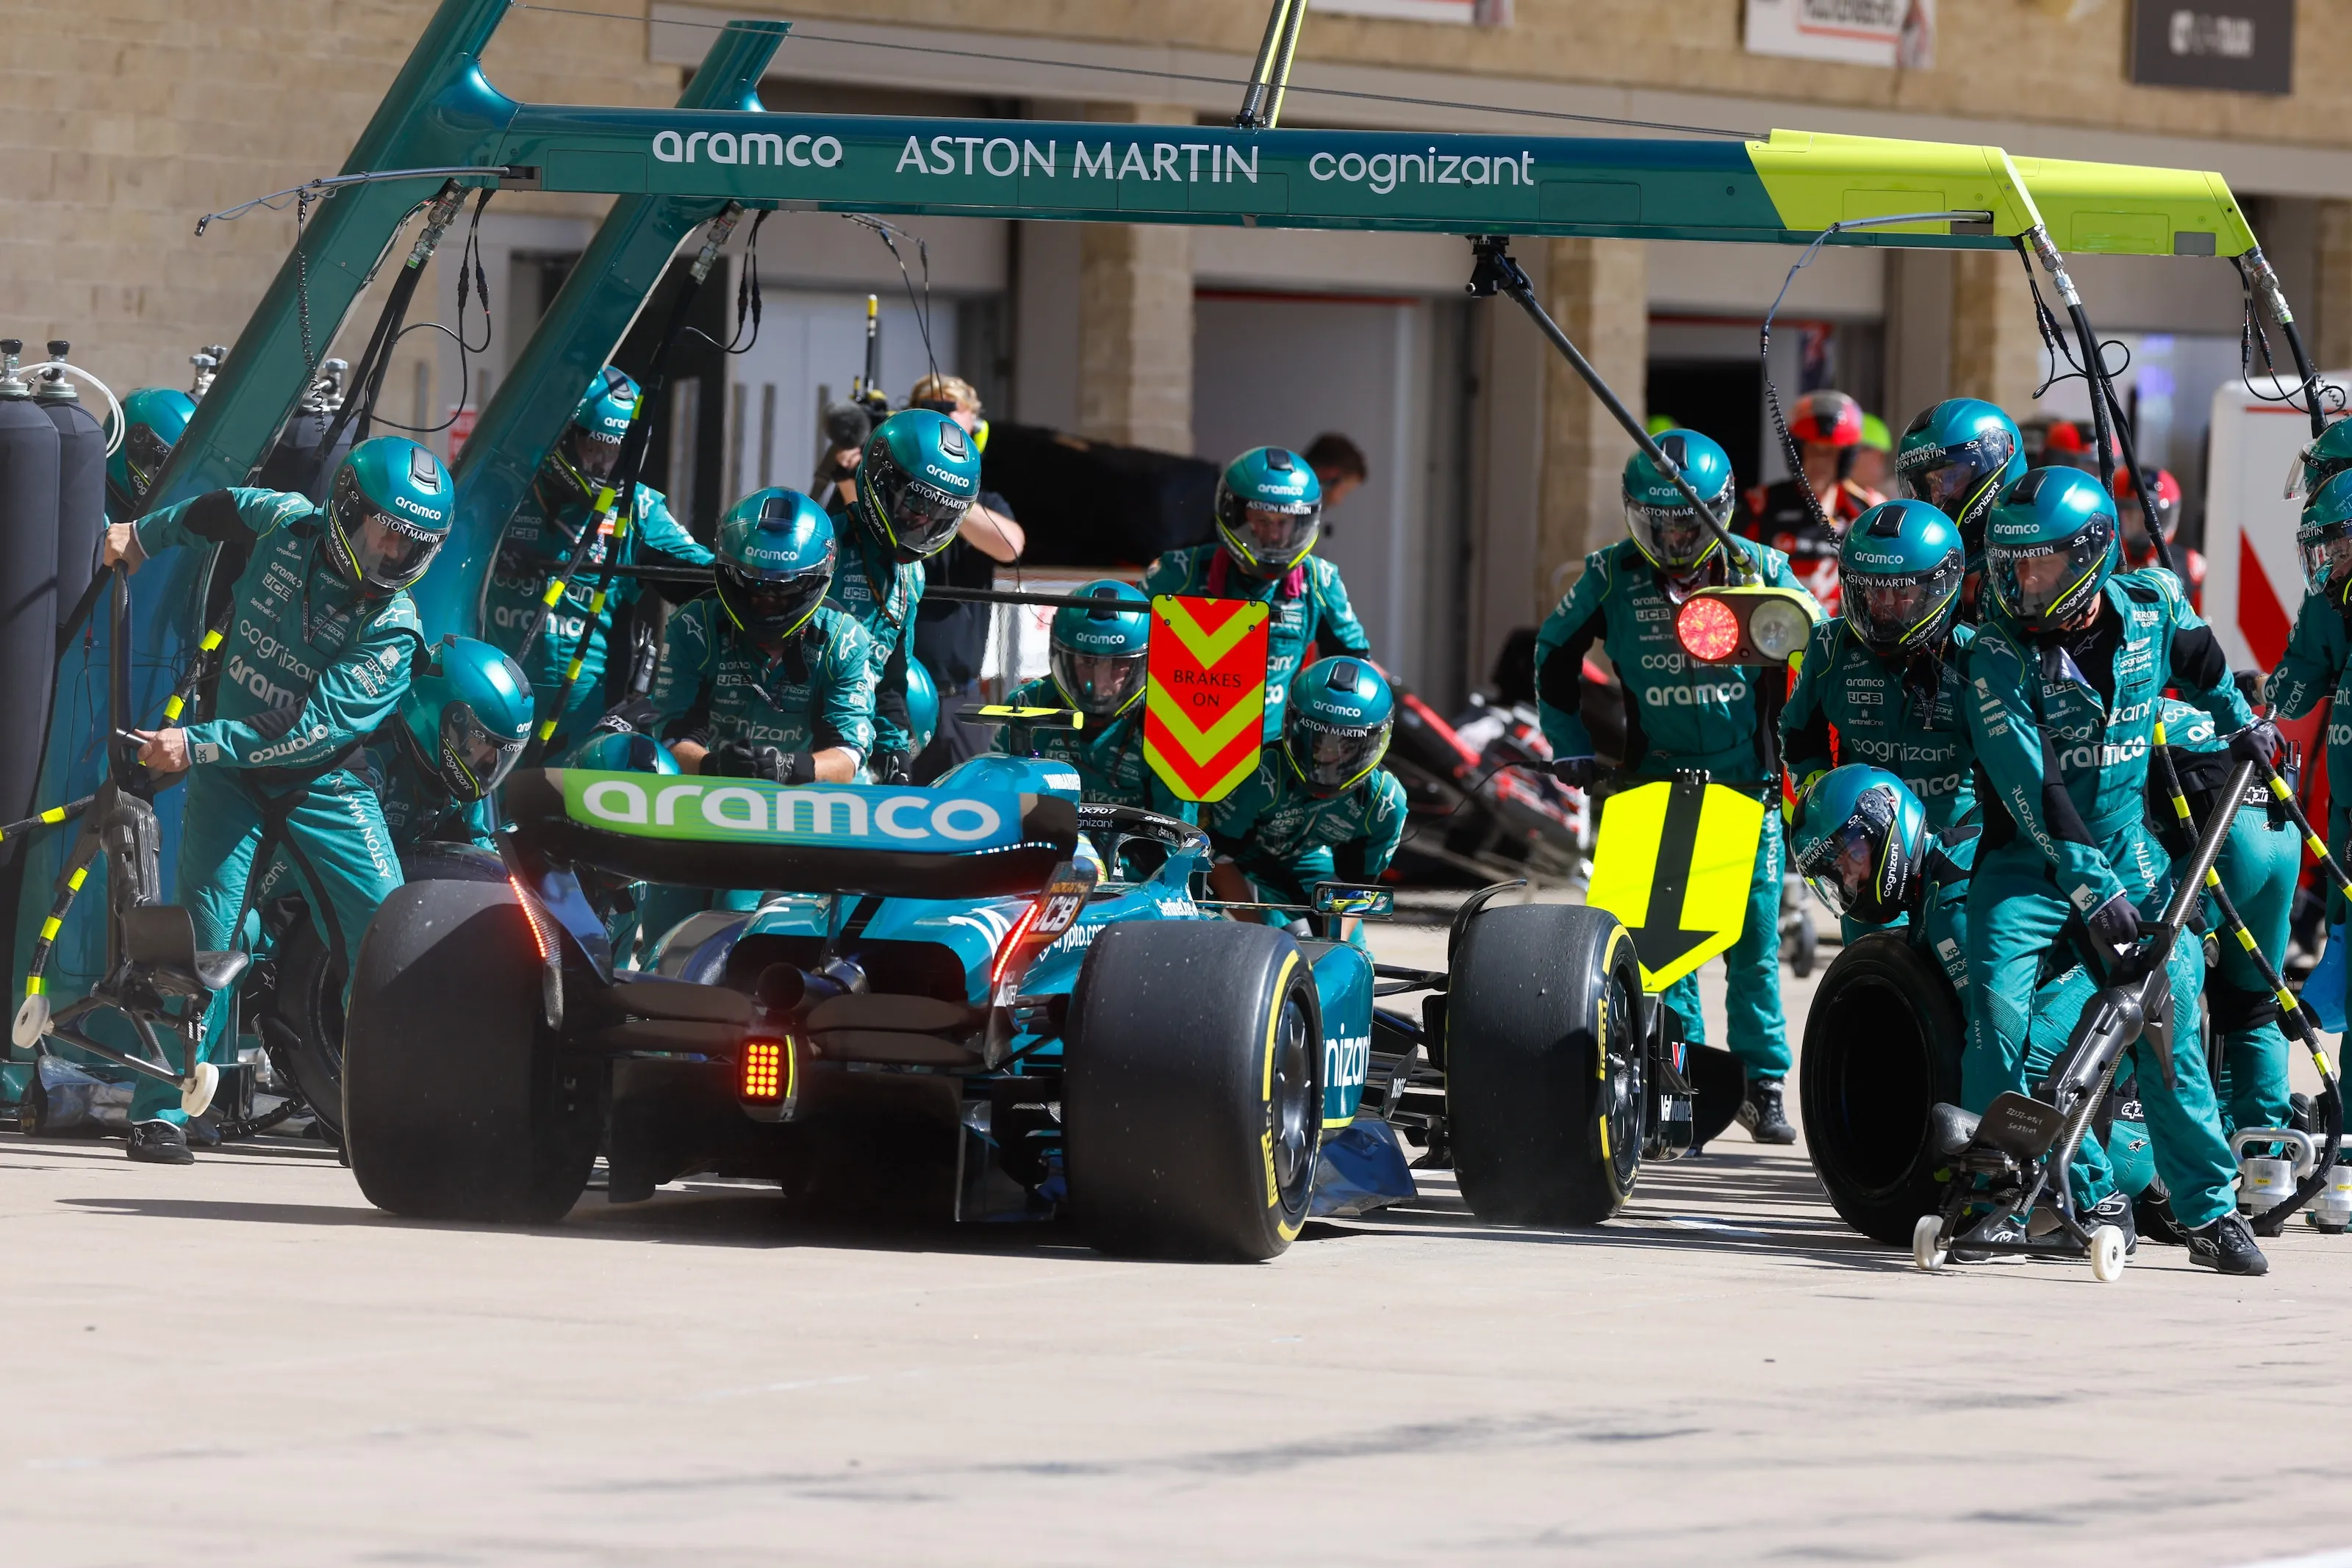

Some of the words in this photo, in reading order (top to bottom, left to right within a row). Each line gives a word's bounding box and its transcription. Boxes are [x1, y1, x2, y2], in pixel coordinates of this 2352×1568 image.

[653, 130, 843, 168] aramco
[895, 135, 1055, 178] ASTON
[1073, 140, 1258, 184] MARTIN
[1309, 147, 1535, 195] cognizant
[588, 431, 622, 445] ASTON
[1899, 442, 1937, 461] aramco
[1911, 447, 1947, 464] MARTIN
[926, 464, 969, 488] aramco
[907, 480, 939, 502] ASTON
[938, 496, 969, 510] MARTIN
[1258, 483, 1304, 496] aramco
[395, 496, 442, 521] aramco
[863, 486, 886, 534] cognizant
[1246, 500, 1278, 512] ASTON
[1279, 506, 1312, 514] MARTIN
[1640, 506, 1670, 517] ASTON
[1964, 481, 2001, 524] cognizant
[373, 512, 406, 535] ASTON
[408, 528, 440, 544] MARTIN
[1993, 524, 2040, 535] aramco
[2298, 526, 2324, 540] MARTIN
[329, 516, 351, 567] cognizant
[745, 546, 797, 561] aramco
[1854, 551, 1904, 564] aramco
[1988, 547, 2011, 558] ASTON
[2012, 545, 2054, 558] MARTIN
[270, 561, 303, 589] aramco
[1846, 572, 1873, 586] ASTON
[1875, 577, 1917, 588] MARTIN
[844, 588, 870, 601] JCB
[2056, 572, 2098, 614] cognizant
[1636, 608, 1671, 622] JCB
[2132, 610, 2159, 619] PERONI
[1906, 607, 1947, 645] cognizant
[1076, 632, 1125, 644] aramco
[1843, 659, 1869, 670] crypto.com
[2120, 652, 2152, 669] cognizant
[365, 658, 387, 686] EPOS
[1173, 669, 1241, 688] BRAKES
[1846, 678, 1885, 688] aramco
[1192, 692, 1219, 707] ON
[1646, 682, 1747, 707] aramco
[1847, 691, 1883, 705] JCB
[1313, 700, 1361, 717] aramco
[2046, 705, 2082, 720] SentinelOne
[1299, 717, 1328, 734] ASTON
[1330, 727, 1368, 738] MARTIN
[1848, 718, 1884, 726] SentinelOne
[249, 724, 329, 763] aramco
[1851, 738, 1957, 763] cognizant
[443, 748, 473, 791] cognizant
[583, 780, 1001, 841] aramco
[1144, 816, 1177, 825] aramco
[2012, 784, 2060, 863] cognizant
[360, 826, 391, 878] ASTON
[1766, 837, 1778, 882] ASTON
[1805, 837, 1835, 868] MARTIN
[1883, 843, 1899, 898] cognizant
[2081, 892, 2095, 907] xp
[1030, 895, 1078, 932] JCB
[1944, 947, 1959, 958] xp
[1974, 1020, 1982, 1050] DAVEY
[1391, 1078, 1406, 1098] BOSS
